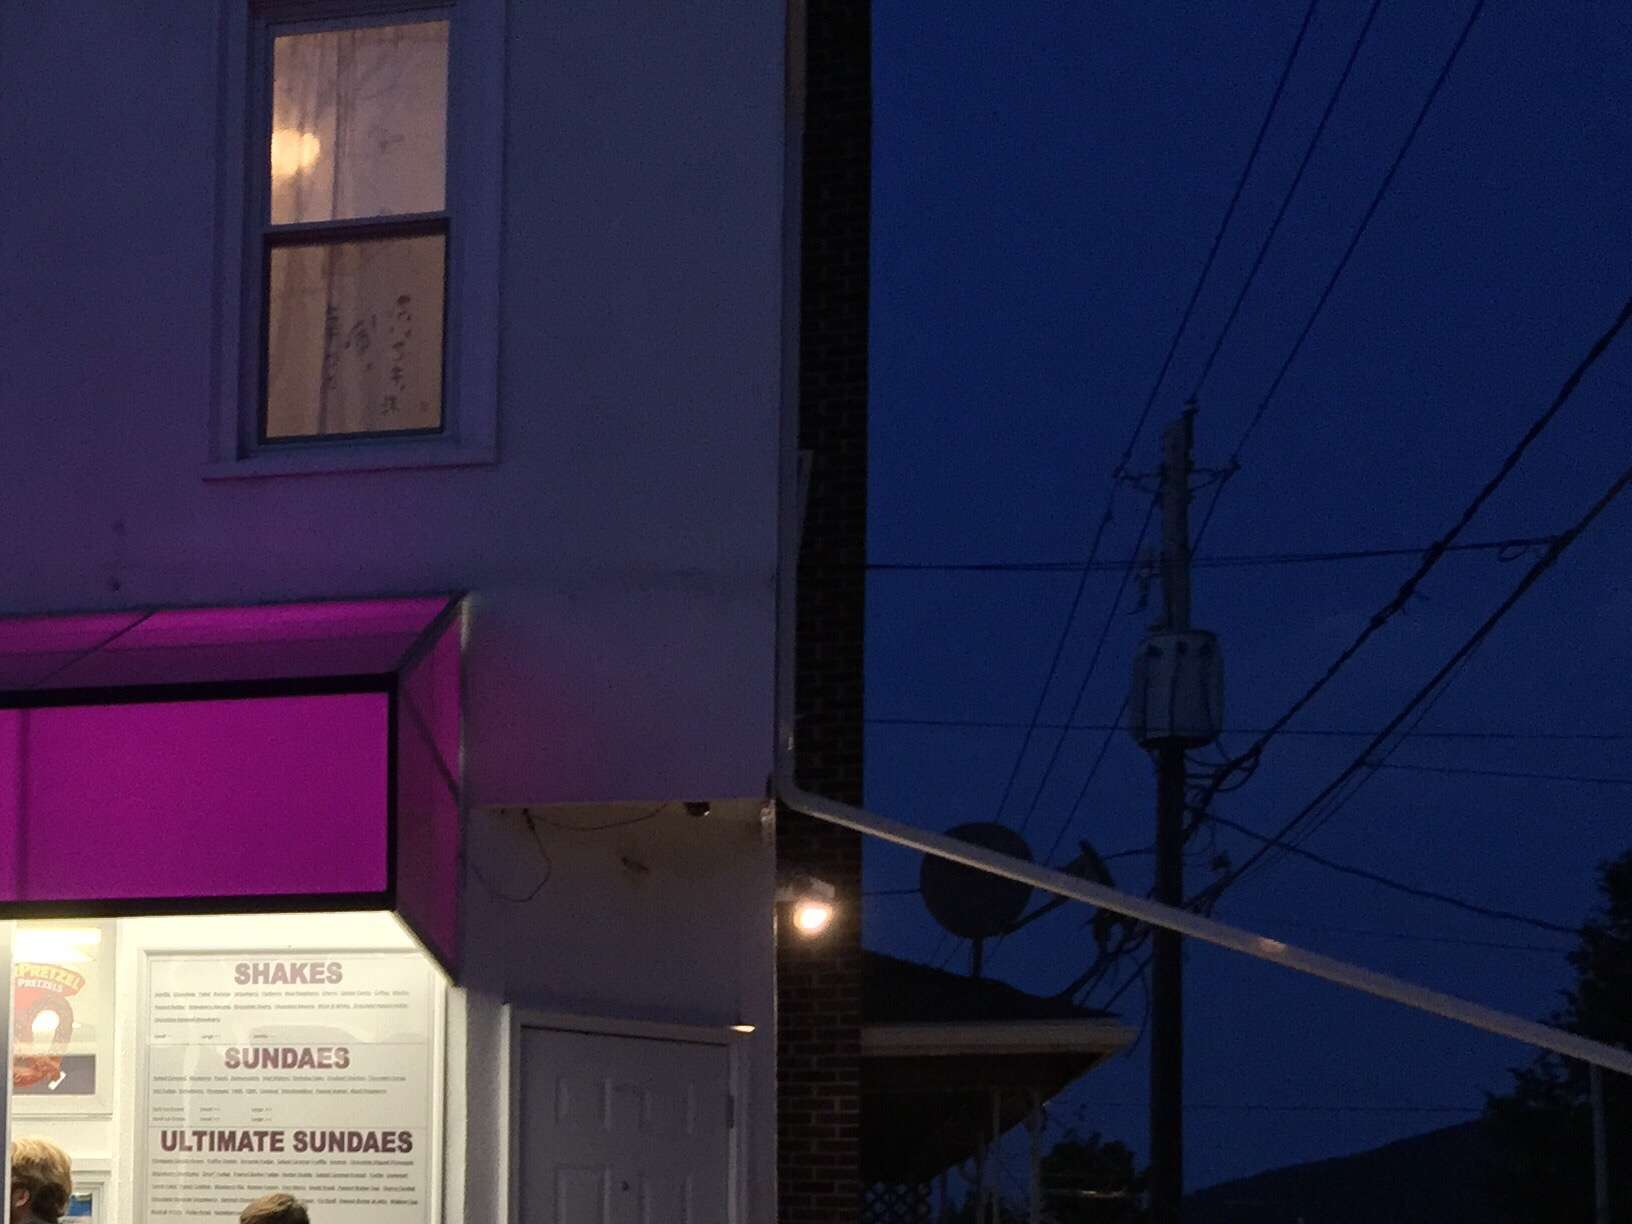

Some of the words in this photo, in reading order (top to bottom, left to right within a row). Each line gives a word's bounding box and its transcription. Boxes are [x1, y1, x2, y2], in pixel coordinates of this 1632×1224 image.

[234, 962, 343, 985] SHAKES
[225, 1047, 351, 1069] SUNDAES
[160, 1130, 285, 1152] ULTIMATE
[292, 1131, 414, 1153] SUNDAES
